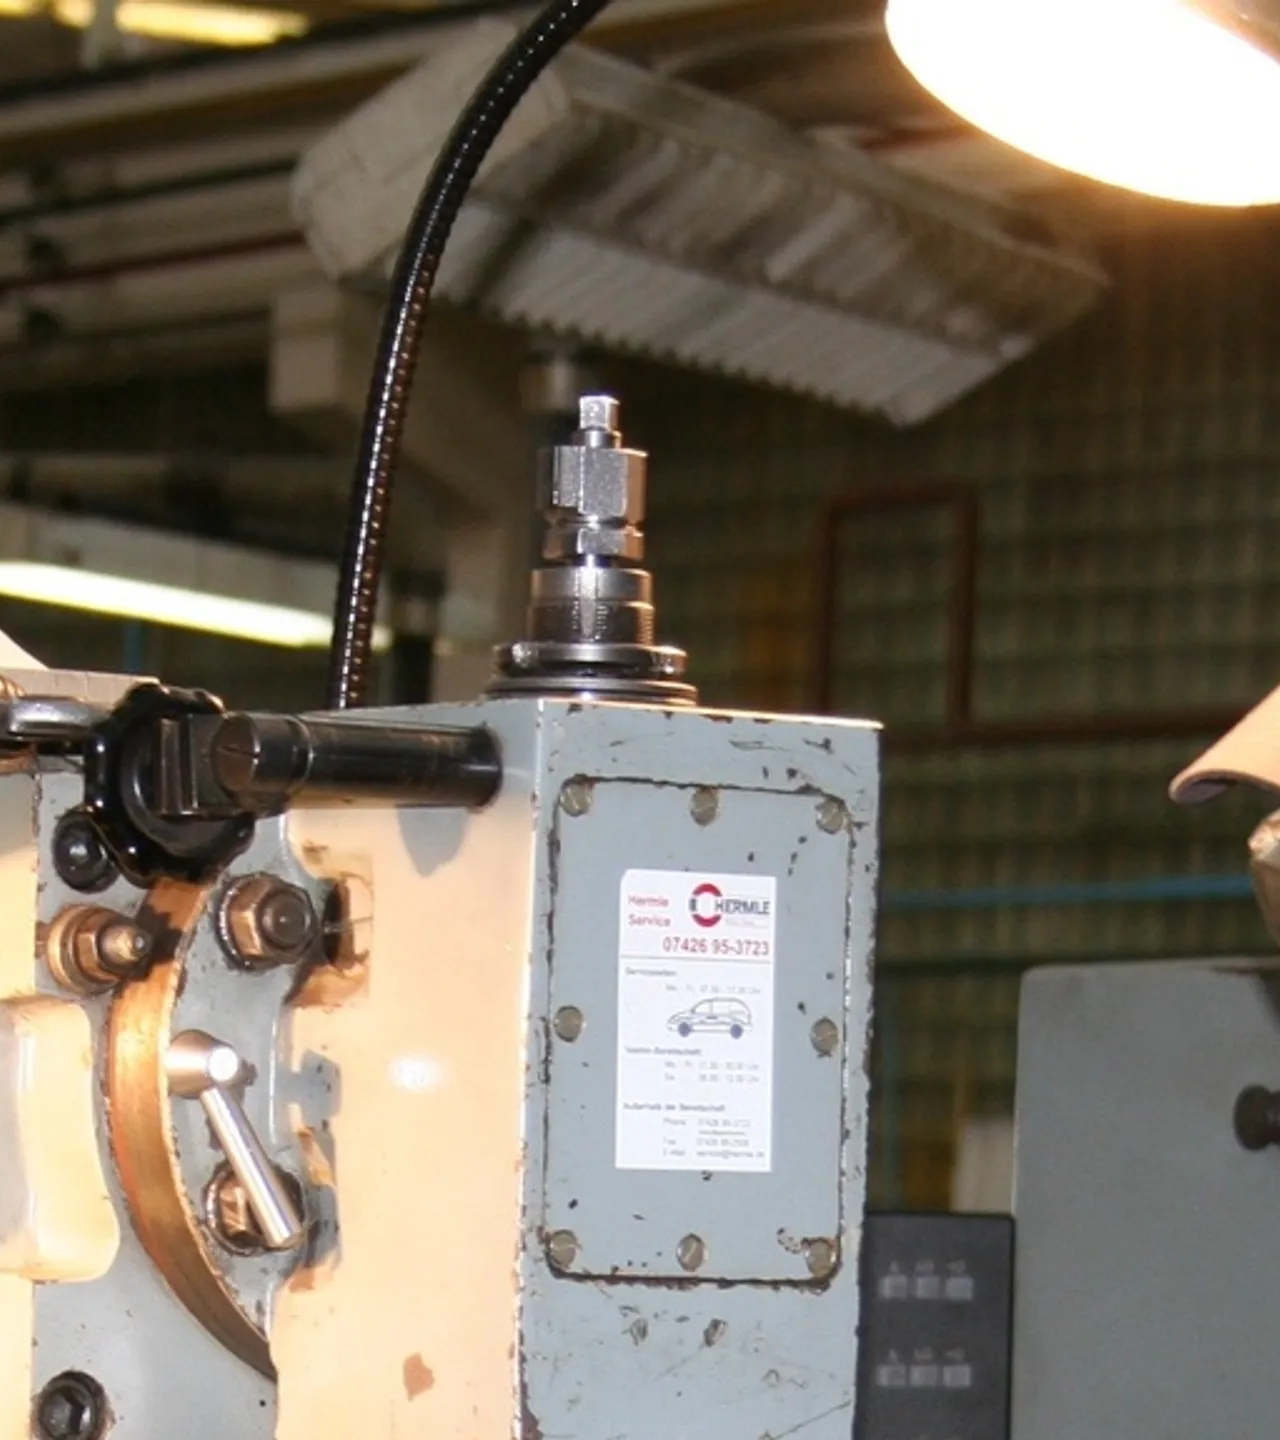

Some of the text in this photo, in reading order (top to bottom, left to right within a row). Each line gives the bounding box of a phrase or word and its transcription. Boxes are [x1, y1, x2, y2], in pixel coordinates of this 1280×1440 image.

[714, 899, 771, 915] HERMLE
[628, 913, 671, 927] Service
[662, 936, 770, 956] 07426 95-3723
